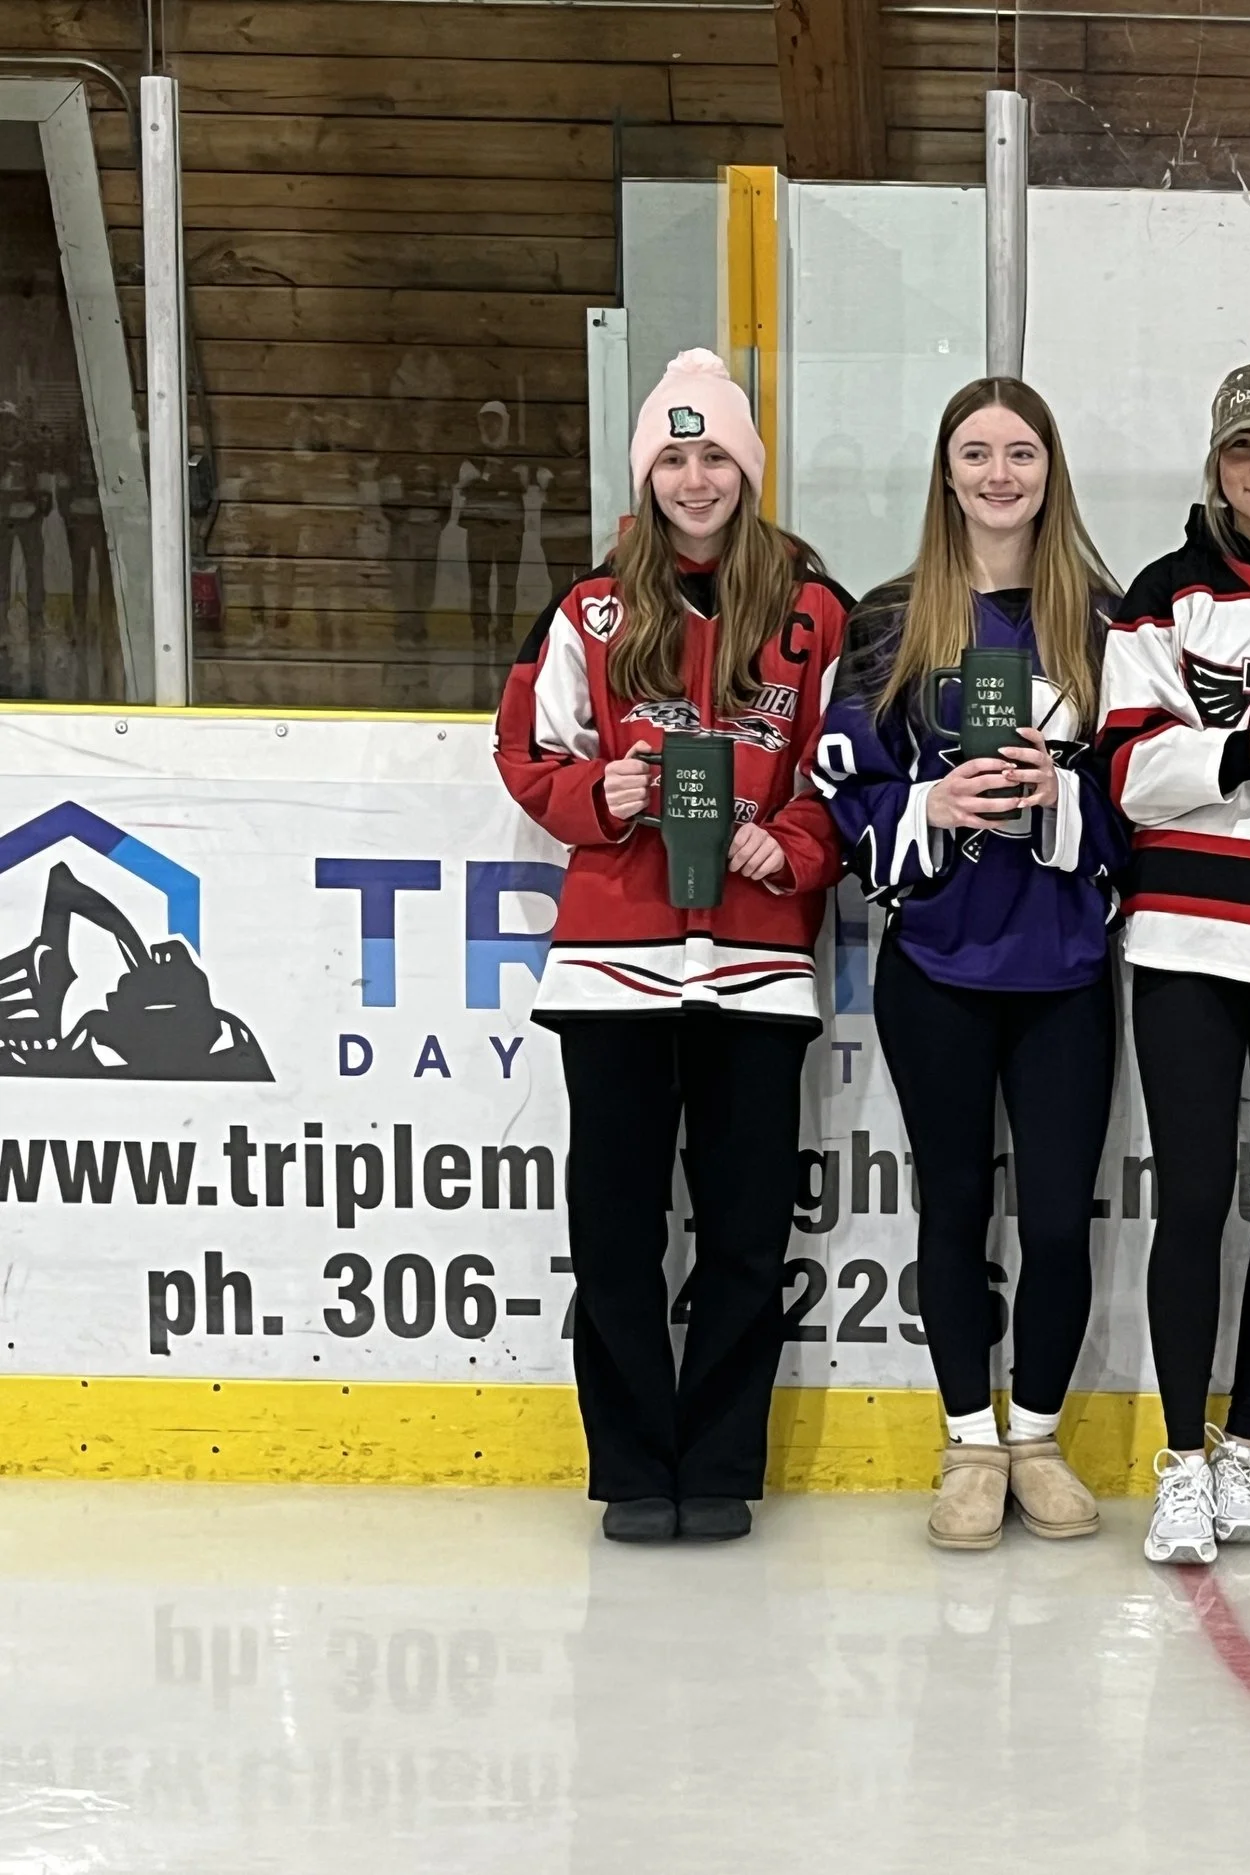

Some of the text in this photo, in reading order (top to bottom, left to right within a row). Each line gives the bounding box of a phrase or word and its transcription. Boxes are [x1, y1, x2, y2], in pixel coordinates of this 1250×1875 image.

[780, 611, 815, 664] C
[755, 686, 799, 718] DEN
[148, 1251, 284, 1356] ph.
